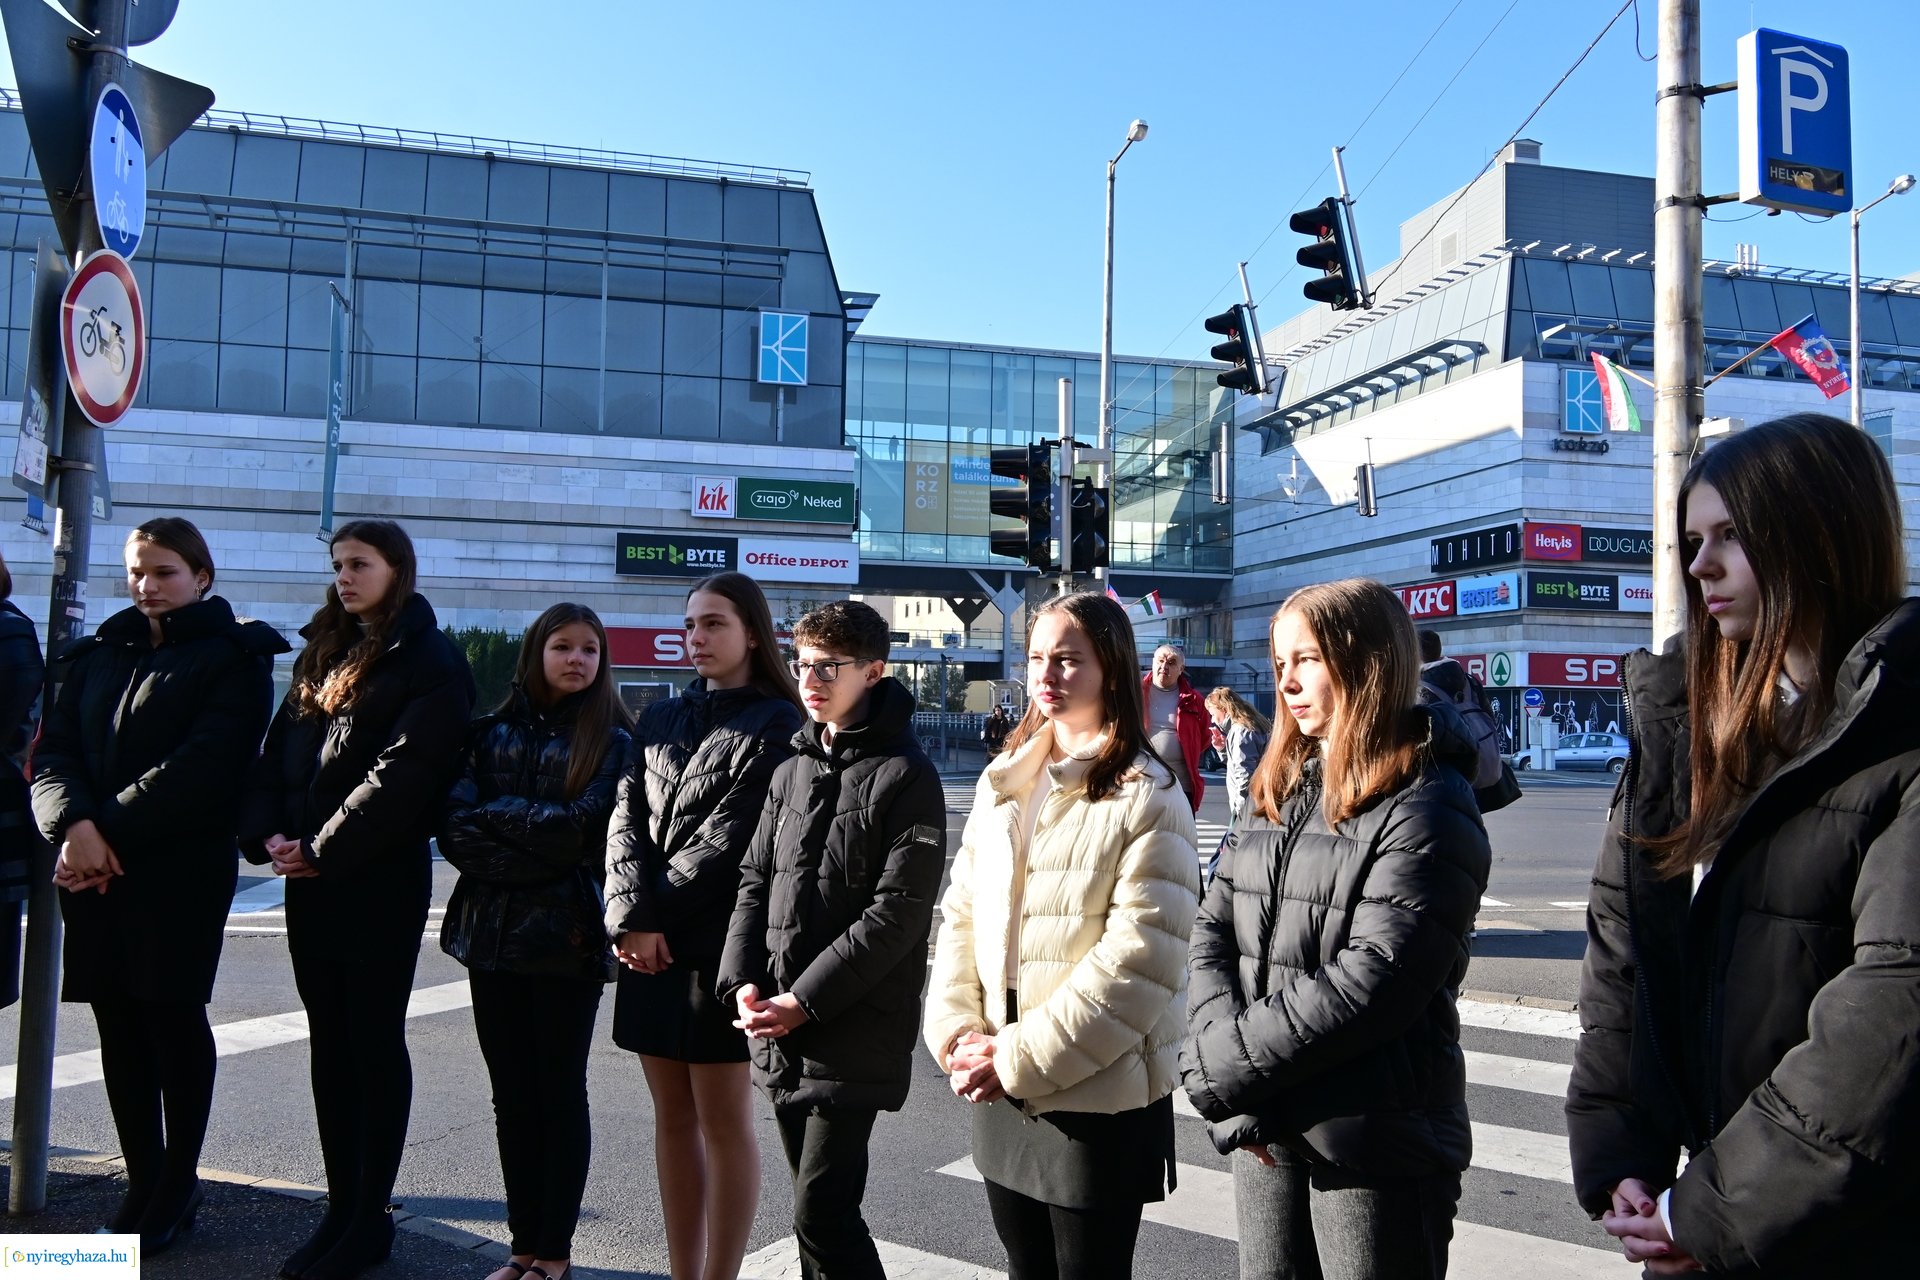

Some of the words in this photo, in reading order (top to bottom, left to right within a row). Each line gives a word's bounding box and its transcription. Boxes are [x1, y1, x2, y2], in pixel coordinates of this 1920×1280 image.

[1780, 57, 1829, 155] P
[803, 495, 842, 508] Neked
[1431, 530, 1512, 566] MOHITO
[1535, 533, 1572, 551] Hervis
[626, 546, 666, 561] BEST
[686, 548, 726, 563] BYTE
[745, 552, 797, 567] Office
[799, 557, 849, 568] DEPOT
[1461, 587, 1498, 609] ERSTE
[1536, 583, 1565, 595] BEST
[1580, 585, 1610, 597] BYTE
[1409, 585, 1451, 615] KFC
